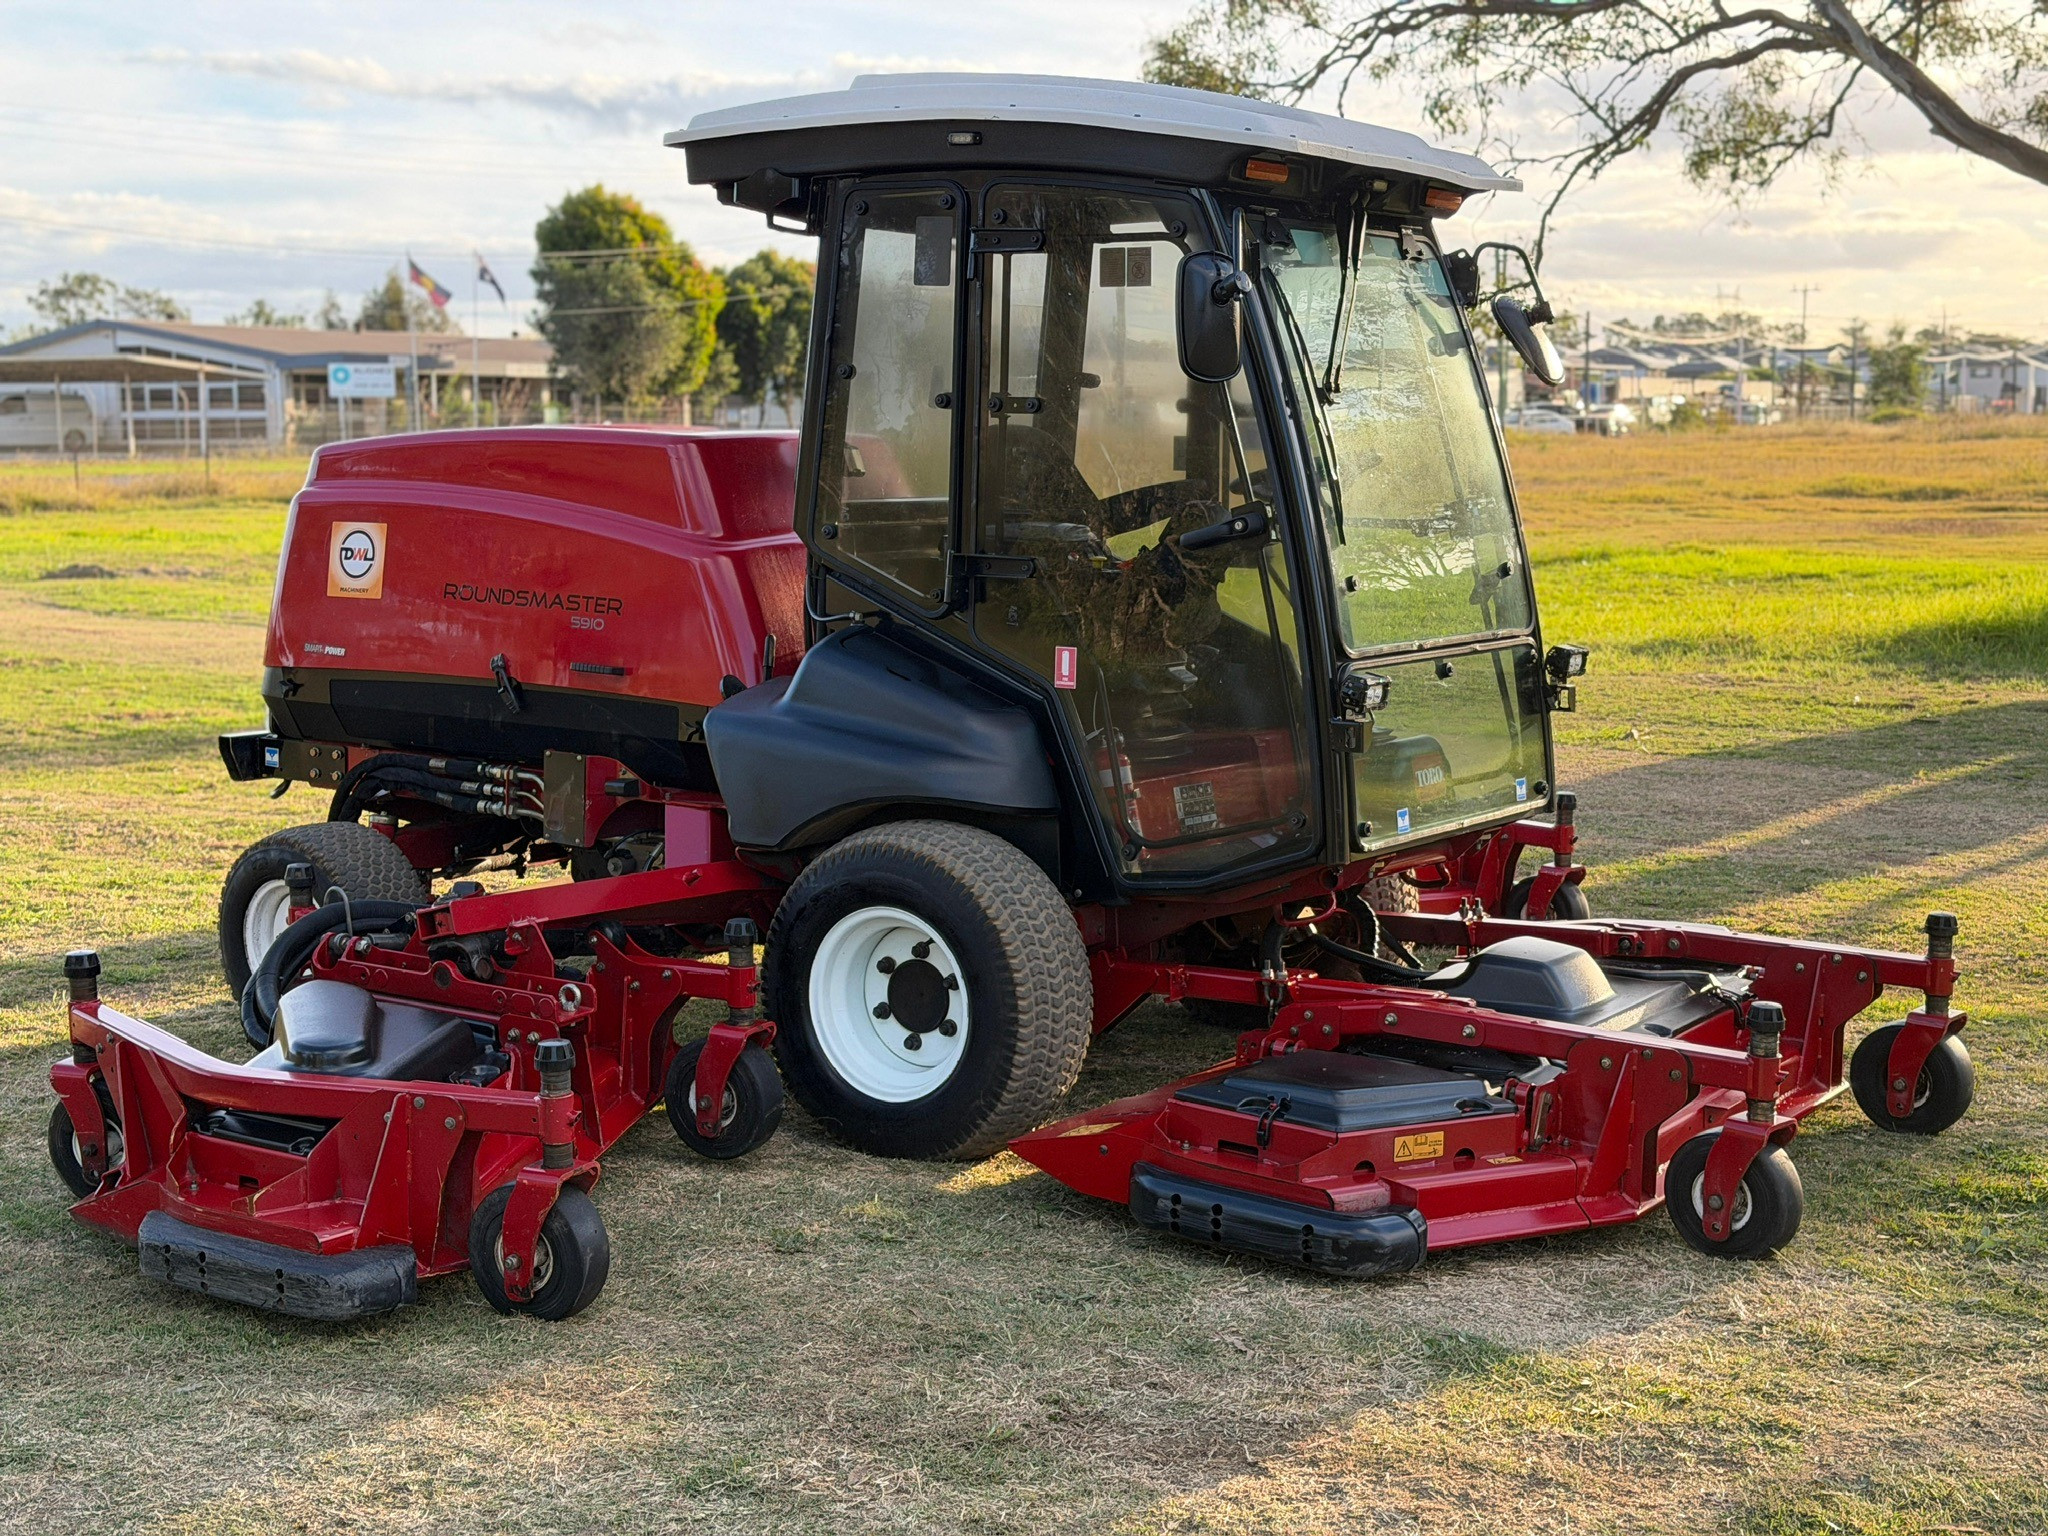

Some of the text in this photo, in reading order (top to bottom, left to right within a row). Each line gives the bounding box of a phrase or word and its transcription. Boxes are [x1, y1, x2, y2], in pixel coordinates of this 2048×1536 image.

[341, 547, 374, 561] DWL
[443, 583, 623, 616] ROUNDSMASTER
[570, 616, 605, 631] 5910
[324, 646, 346, 657] POWER
[1415, 766, 1444, 787] TORO
